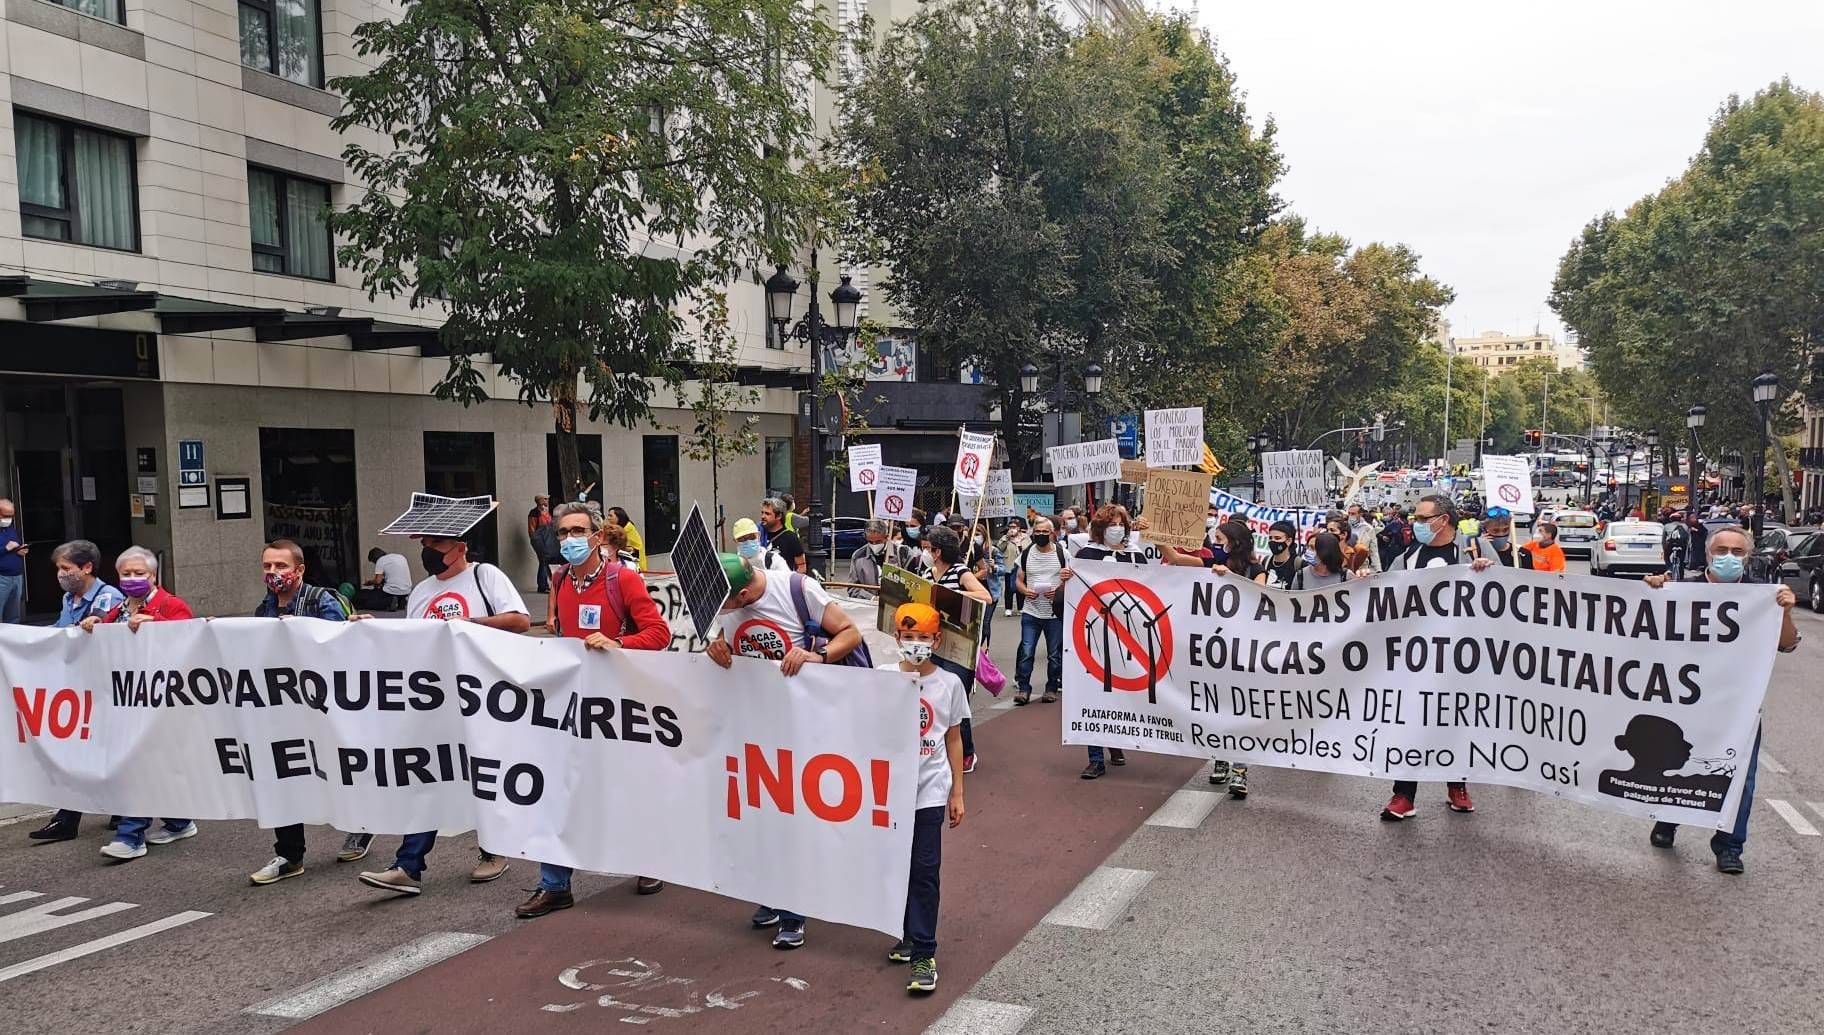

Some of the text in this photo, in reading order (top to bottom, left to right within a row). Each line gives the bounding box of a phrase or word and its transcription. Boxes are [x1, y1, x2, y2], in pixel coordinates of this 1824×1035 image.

[1168, 425, 1200, 438] MOLINOS
[1015, 498, 1052, 506] ACIONAL
[1295, 480, 1305, 490] LA
[1211, 489, 1328, 527] ORTANETE
[1191, 580, 1740, 644] NO A LAS MACROCENTRALES
[1189, 627, 1701, 706] EÓLICAS O FOTOVOLTAICAS
[111, 667, 445, 715] MACROPARQUES
[456, 674, 683, 748] SOLARES
[1071, 721, 1185, 743] DE LOS PAISAJES DE TERUEL
[1082, 708, 1174, 727] PLATAFORMA A FAVOR
[1190, 680, 1586, 746] EN DEFENSA DEL TERRITORIO
[270, 738, 328, 781] EL
[1191, 723, 1579, 786] Renovables SÍ pero NO así
[725, 742, 890, 828] ¡NO!
[1609, 776, 1658, 792] Plataforma
[1667, 786, 1692, 795] favor
[1694, 789, 1708, 797] de
[1708, 790, 1723, 799] los
[1660, 795, 1674, 804] de
[1676, 796, 1706, 808] Teruel
